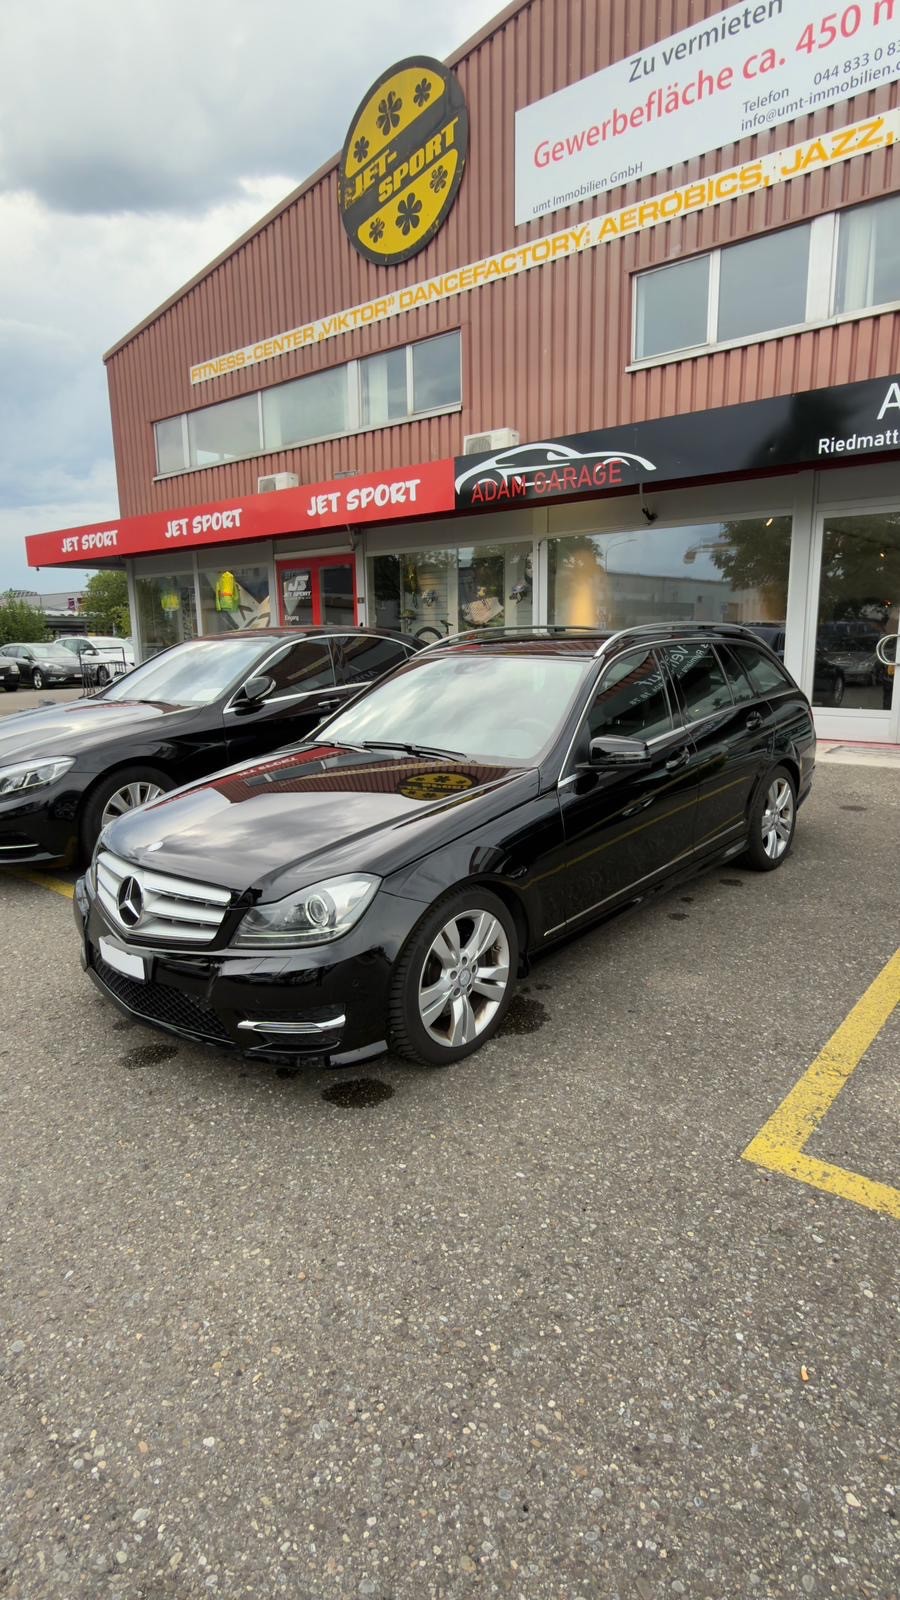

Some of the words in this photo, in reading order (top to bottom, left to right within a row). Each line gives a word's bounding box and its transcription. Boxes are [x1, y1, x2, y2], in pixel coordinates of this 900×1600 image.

[629, 56, 655, 83] Zu
[662, 0, 783, 66] vermieten
[533, 67, 733, 168] Gewerbefläche
[743, 48, 786, 79] ca.
[795, 4, 862, 54] 450
[743, 86, 789, 114] Telefon
[813, 64, 839, 86] 044
[843, 53, 869, 74] 833
[874, 47, 883, 61] 0
[378, 117, 459, 203] SPORT
[598, 163, 770, 240] AEROBICS,
[781, 119, 894, 175] JAZZ,
[532, 200, 551, 214] umt
[553, 177, 607, 206] Immobilien
[609, 161, 643, 183] GmbH
[818, 429, 899, 455] Riedmatt
[307, 491, 341, 516] JET
[346, 479, 421, 511] SPORT
[471, 474, 527, 504] ADAM
[534, 460, 623, 494] GARAGE
[61, 536, 79, 553] JET
[81, 530, 118, 550] SPORT
[165, 518, 189, 538] JET
[192, 508, 243, 534] SPORT
